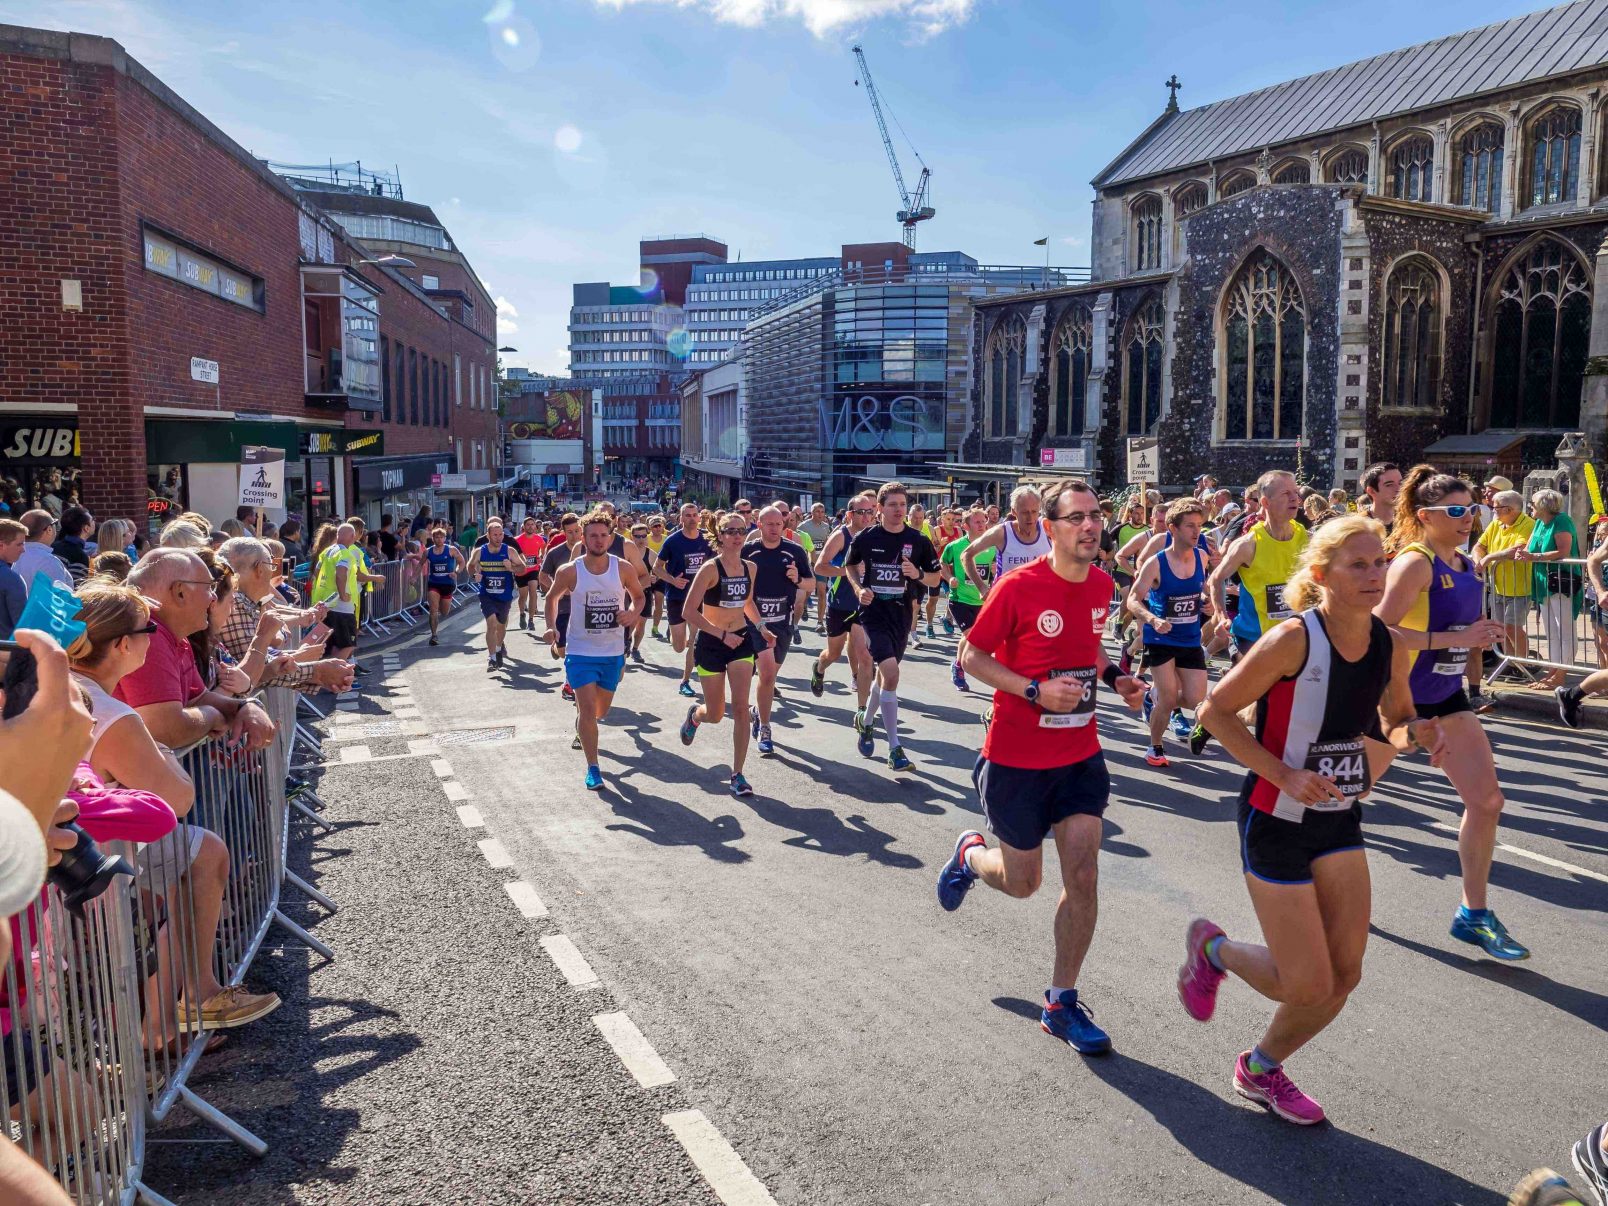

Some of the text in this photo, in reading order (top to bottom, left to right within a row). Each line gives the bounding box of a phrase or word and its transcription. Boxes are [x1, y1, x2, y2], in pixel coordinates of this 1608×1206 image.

[186, 261, 213, 284] SUBWAY
[818, 395, 928, 451] M&S
[3, 428, 81, 458] SUB
[308, 432, 332, 454] SUBWAY
[345, 433, 380, 452] SUBWAY
[382, 468, 404, 490] TOPMAN
[242, 496, 265, 504] point
[243, 488, 278, 500] Crossing
[148, 501, 168, 512] PEN
[688, 556, 704, 566] 397
[876, 569, 900, 582] 202
[488, 579, 502, 587] 213
[727, 583, 746, 596] 508
[761, 603, 780, 613] 971
[1173, 600, 1195, 612] 673
[591, 612, 614, 624] 200
[1318, 754, 1365, 781] 844
